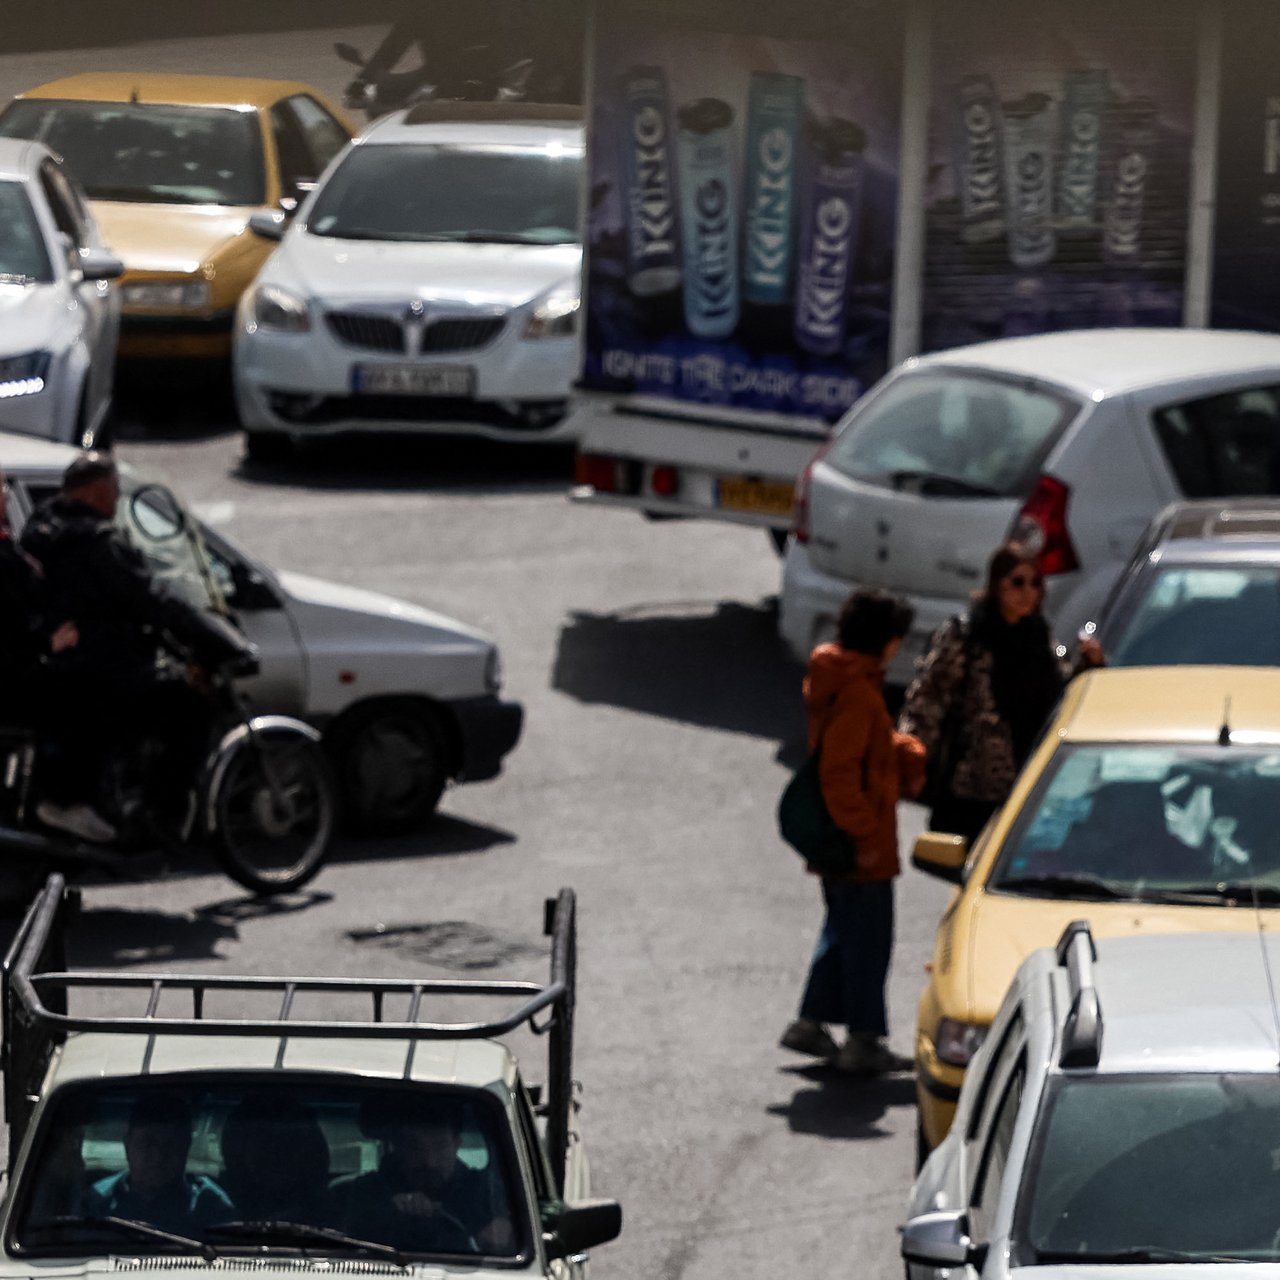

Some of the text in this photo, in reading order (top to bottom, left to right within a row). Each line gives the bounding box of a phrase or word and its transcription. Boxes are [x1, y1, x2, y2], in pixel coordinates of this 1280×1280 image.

[634, 105, 675, 254] KING
[694, 178, 732, 318] KING
[750, 126, 794, 285] KING
[802, 196, 852, 338] KING
